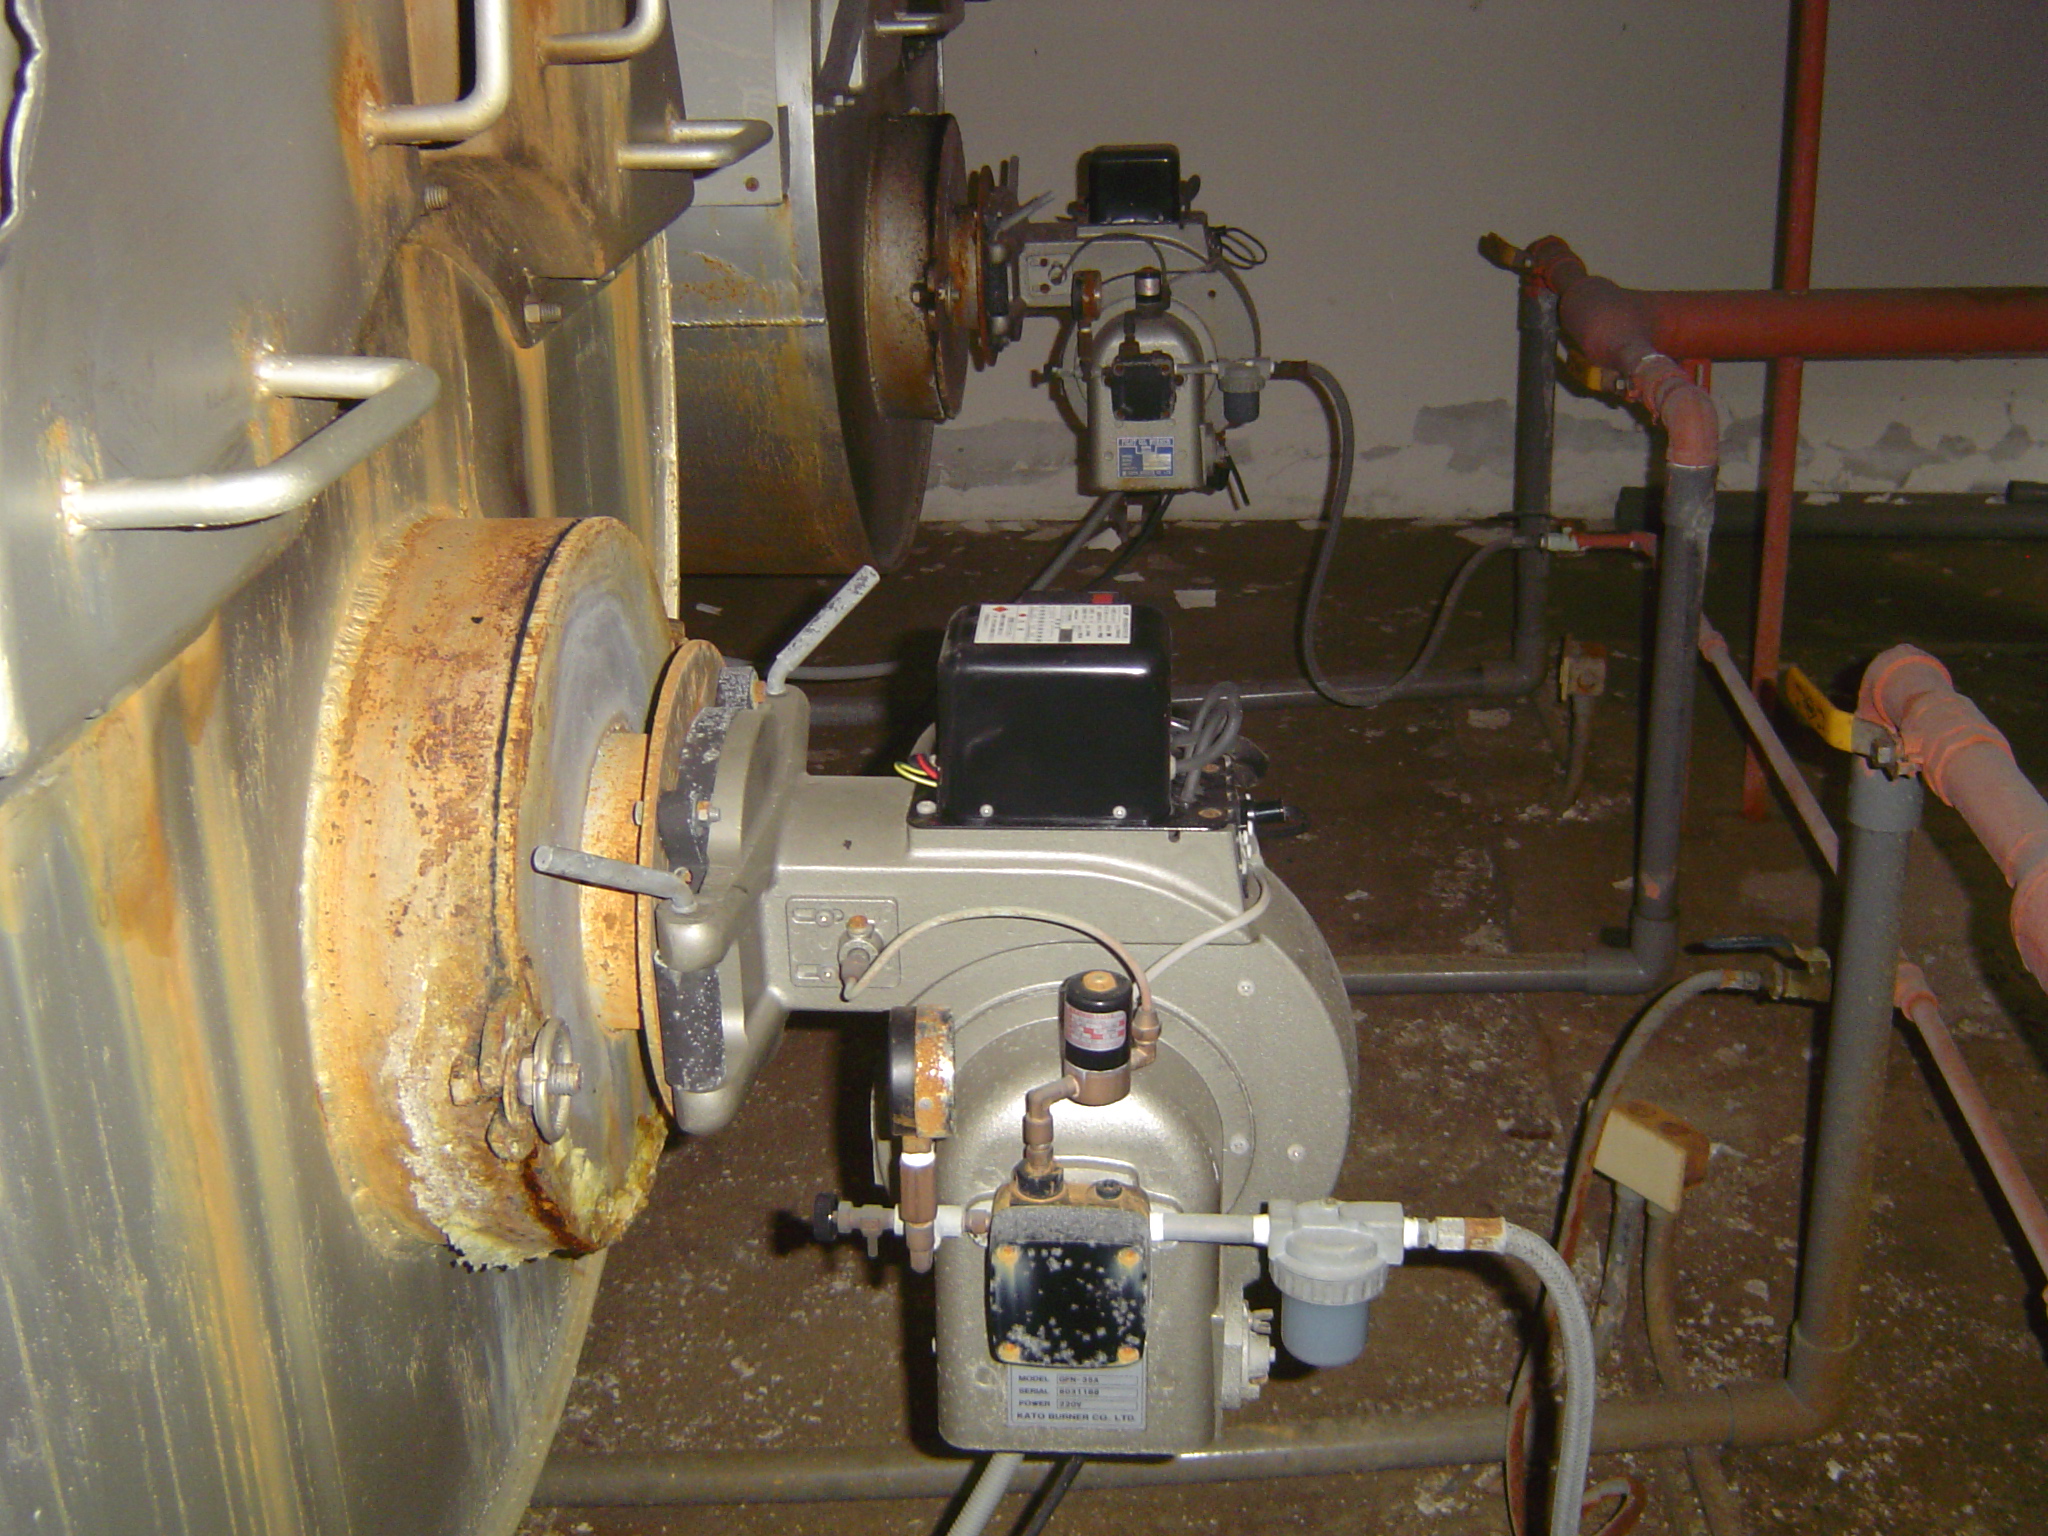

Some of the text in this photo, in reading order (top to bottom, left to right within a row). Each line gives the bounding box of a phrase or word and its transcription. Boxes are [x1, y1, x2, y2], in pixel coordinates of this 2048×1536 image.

[1018, 1374, 1049, 1383] MODEL
[1018, 1387, 1049, 1395] SERIAL
[1059, 1400, 1082, 1408] 220V
[1016, 1411, 1046, 1420] KATO
[1048, 1412, 1089, 1421] BURNER
